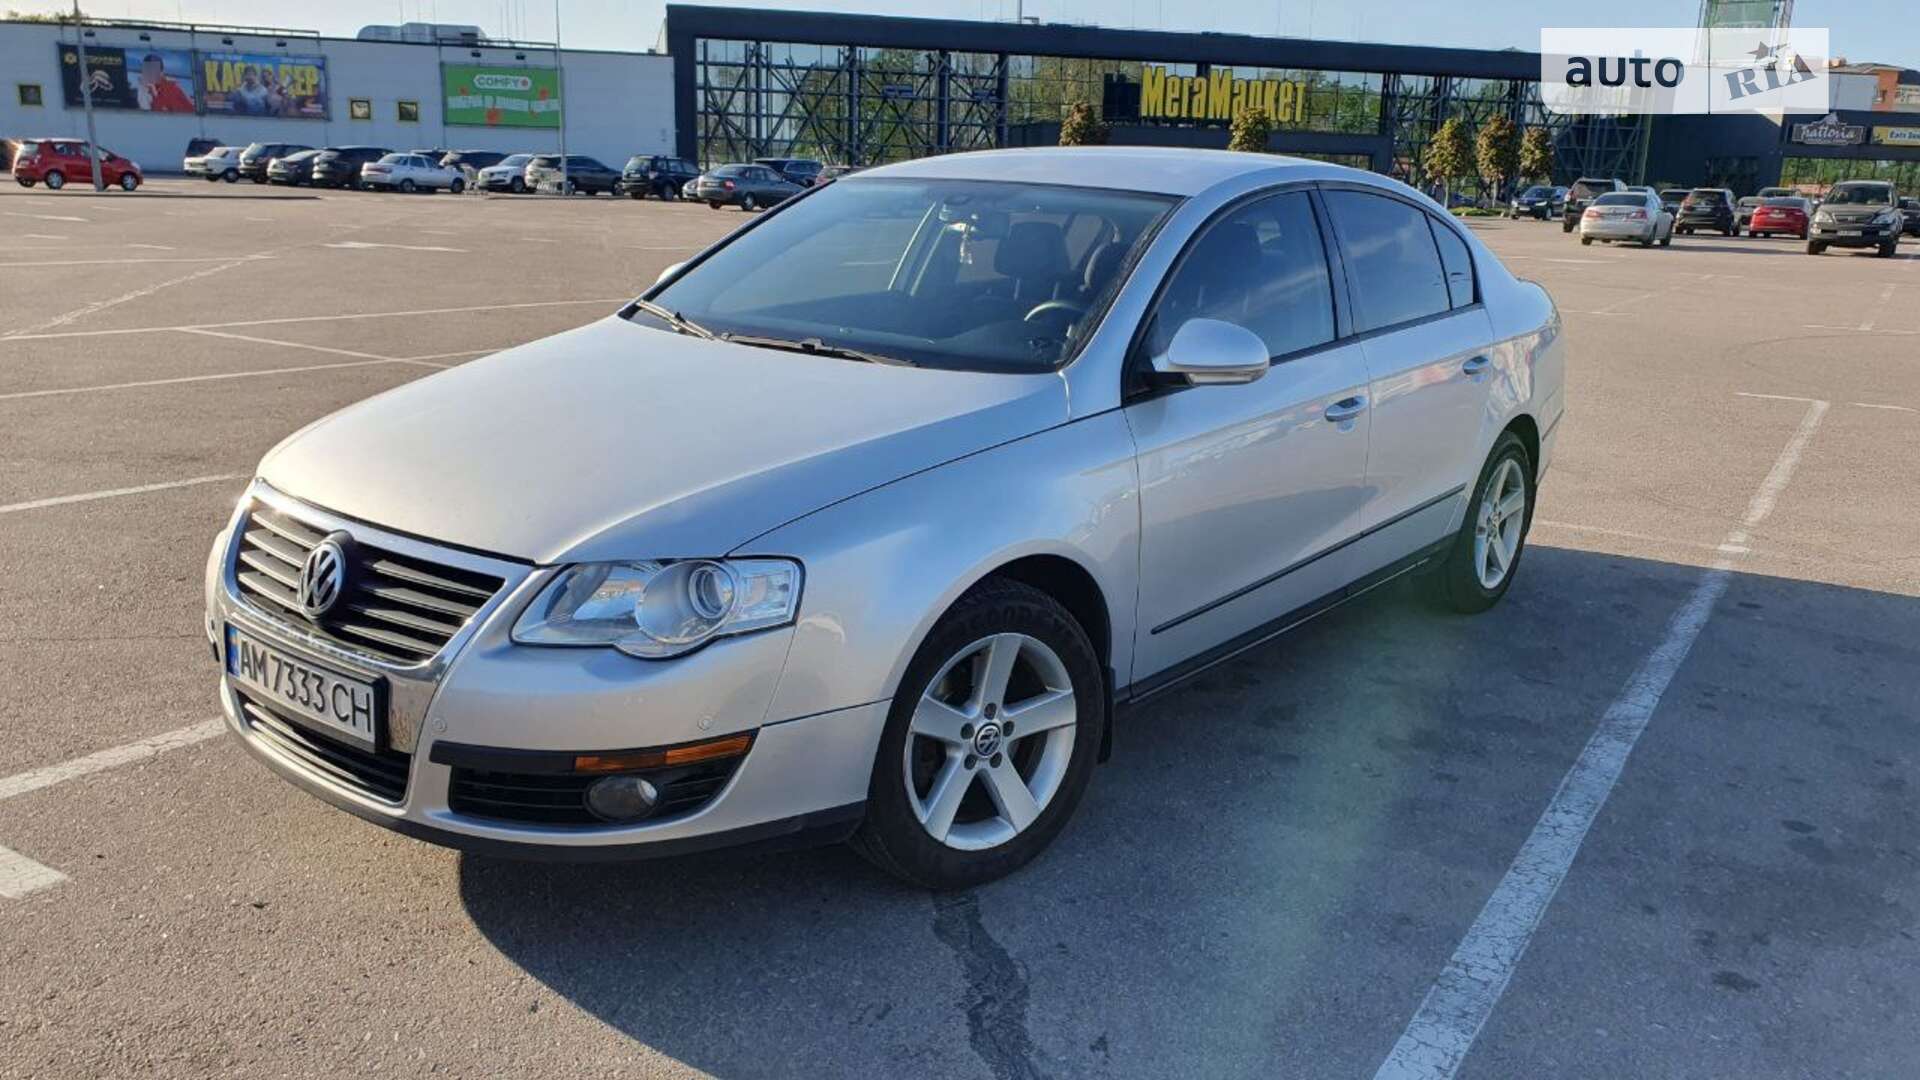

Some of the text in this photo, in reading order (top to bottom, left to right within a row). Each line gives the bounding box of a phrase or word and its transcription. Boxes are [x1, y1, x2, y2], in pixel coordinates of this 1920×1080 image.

[477, 76, 519, 89] COMFY
[240, 640, 371, 732] AM 7333 CH
